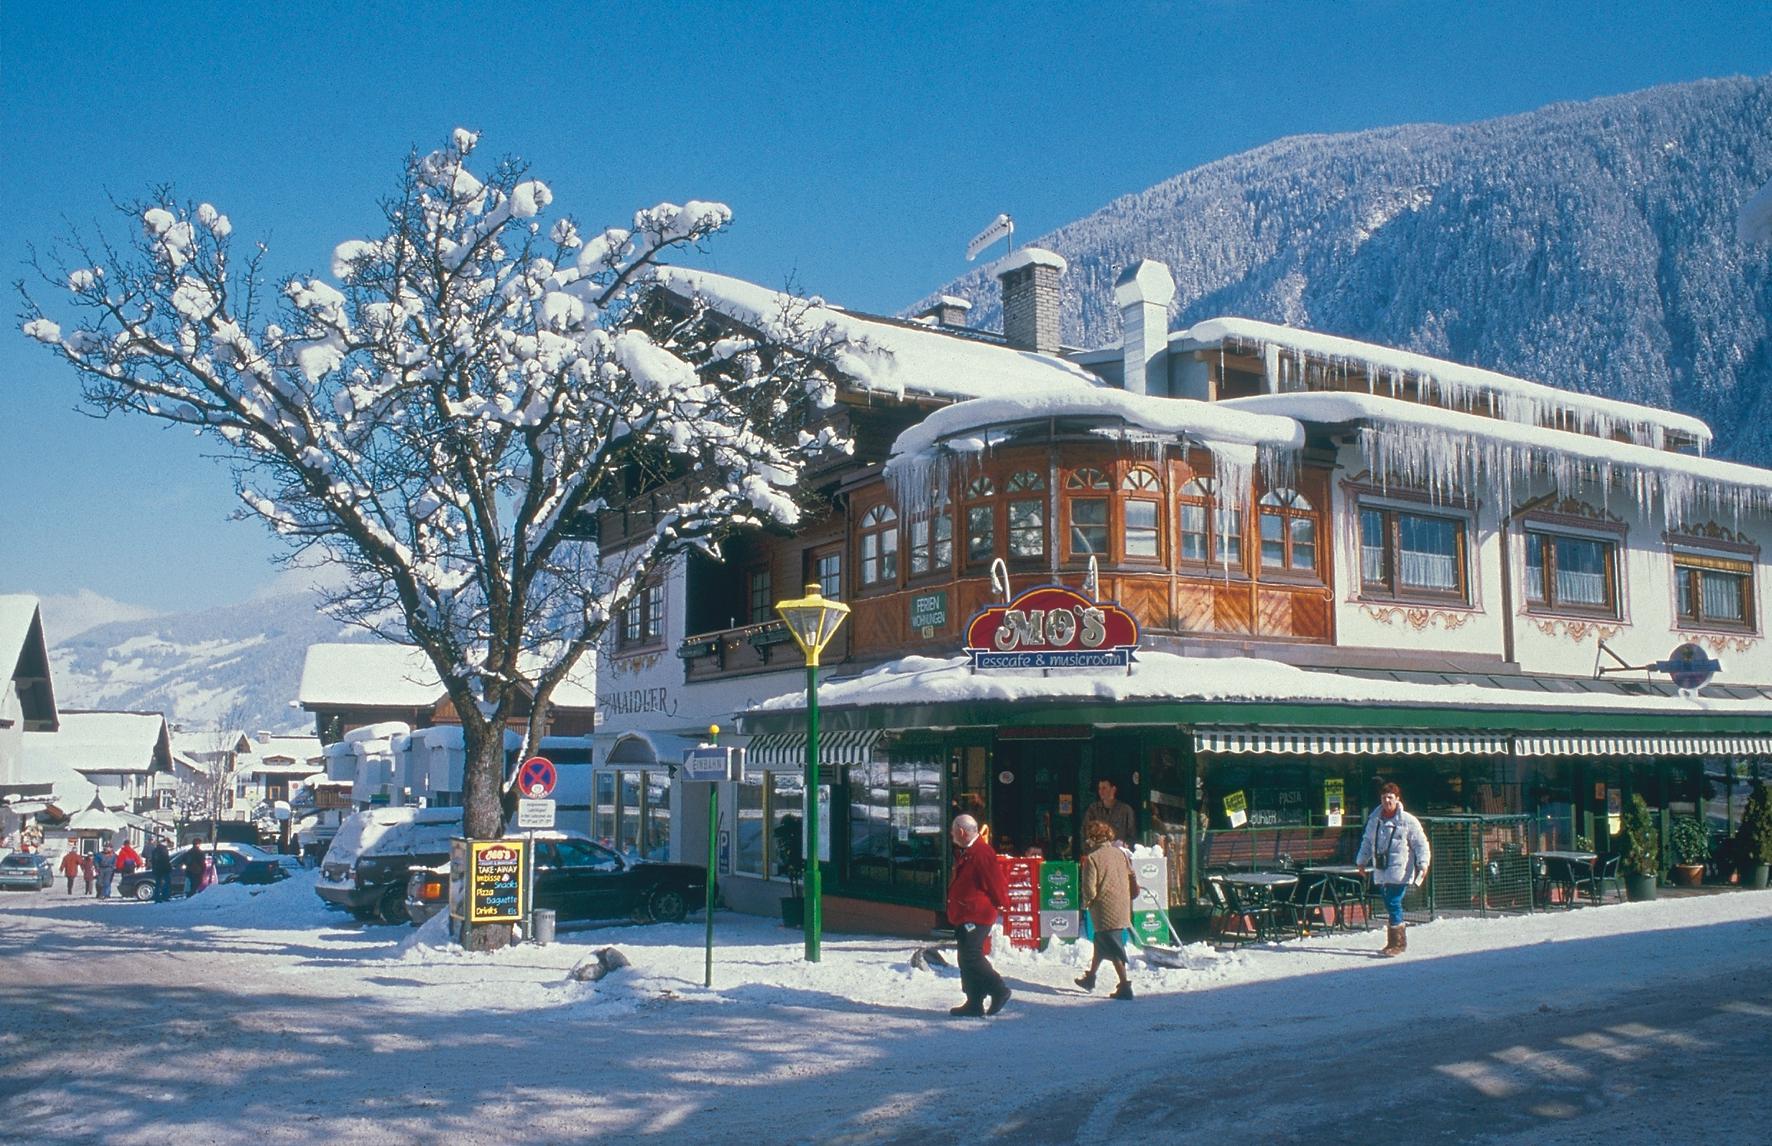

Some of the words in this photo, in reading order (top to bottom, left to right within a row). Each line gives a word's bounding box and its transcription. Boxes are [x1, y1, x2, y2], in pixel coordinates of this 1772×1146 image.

[916, 596, 940, 613] FERIEN
[912, 611, 945, 627] WOHNUNGEN
[995, 605, 1107, 651] MO'S
[982, 654, 1031, 667] esscafe
[1035, 654, 1046, 666] &
[1050, 653, 1121, 667] musicroom
[476, 888, 494, 897] Pizza
[476, 906, 498, 915] Drinks
